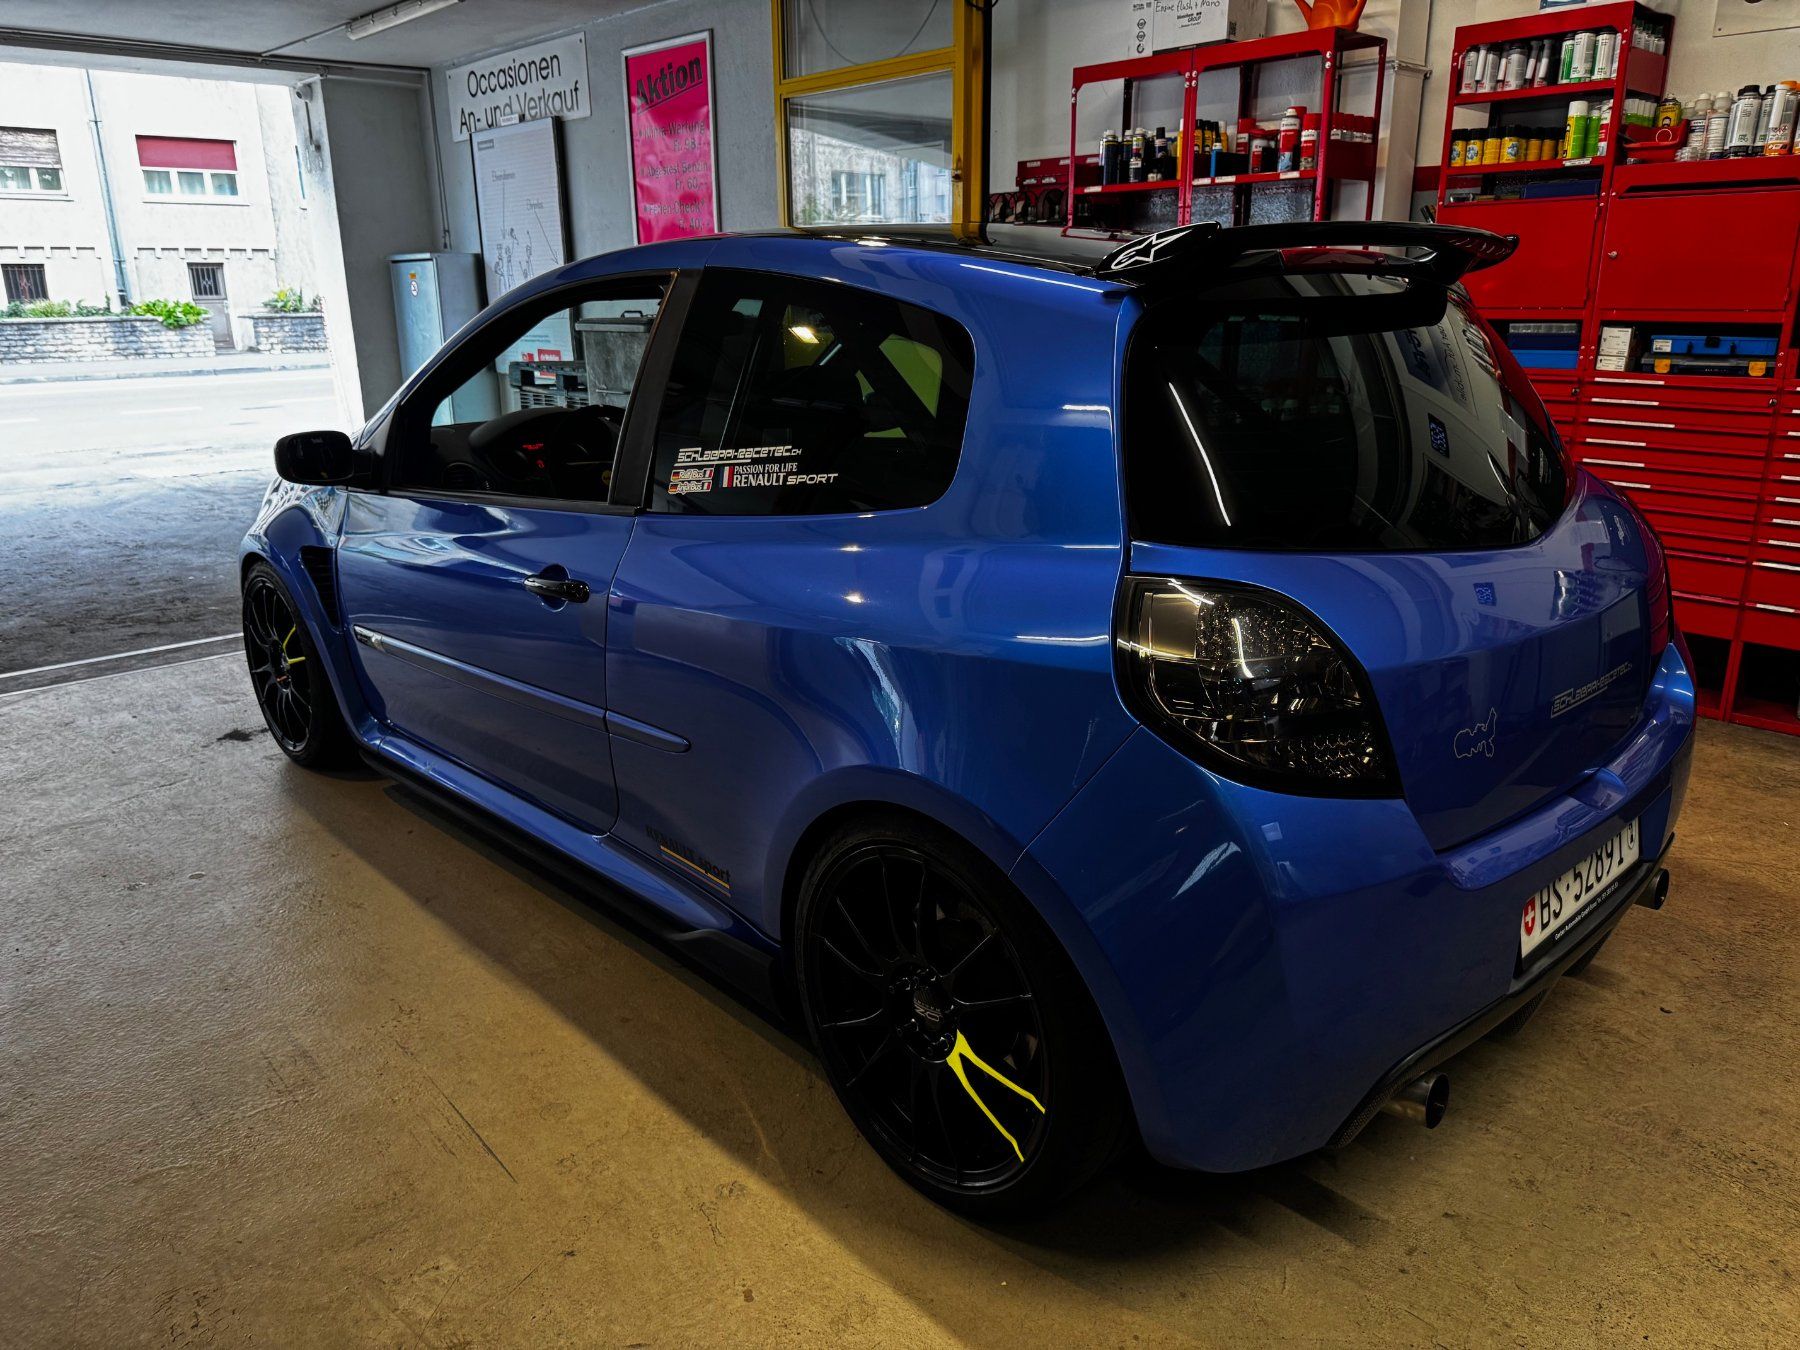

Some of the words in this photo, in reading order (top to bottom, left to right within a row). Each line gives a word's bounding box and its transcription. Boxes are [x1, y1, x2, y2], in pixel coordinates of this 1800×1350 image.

[467, 54, 562, 98] Occasionen
[637, 57, 703, 110] Aktion
[460, 107, 481, 134] An-
[516, 80, 579, 119] Verkauf
[733, 472, 786, 488] RENAULT
[786, 473, 838, 485] SPORT
[734, 464, 763, 474] PASSION
[764, 463, 780, 473] FOR
[781, 462, 798, 472] LIFE
